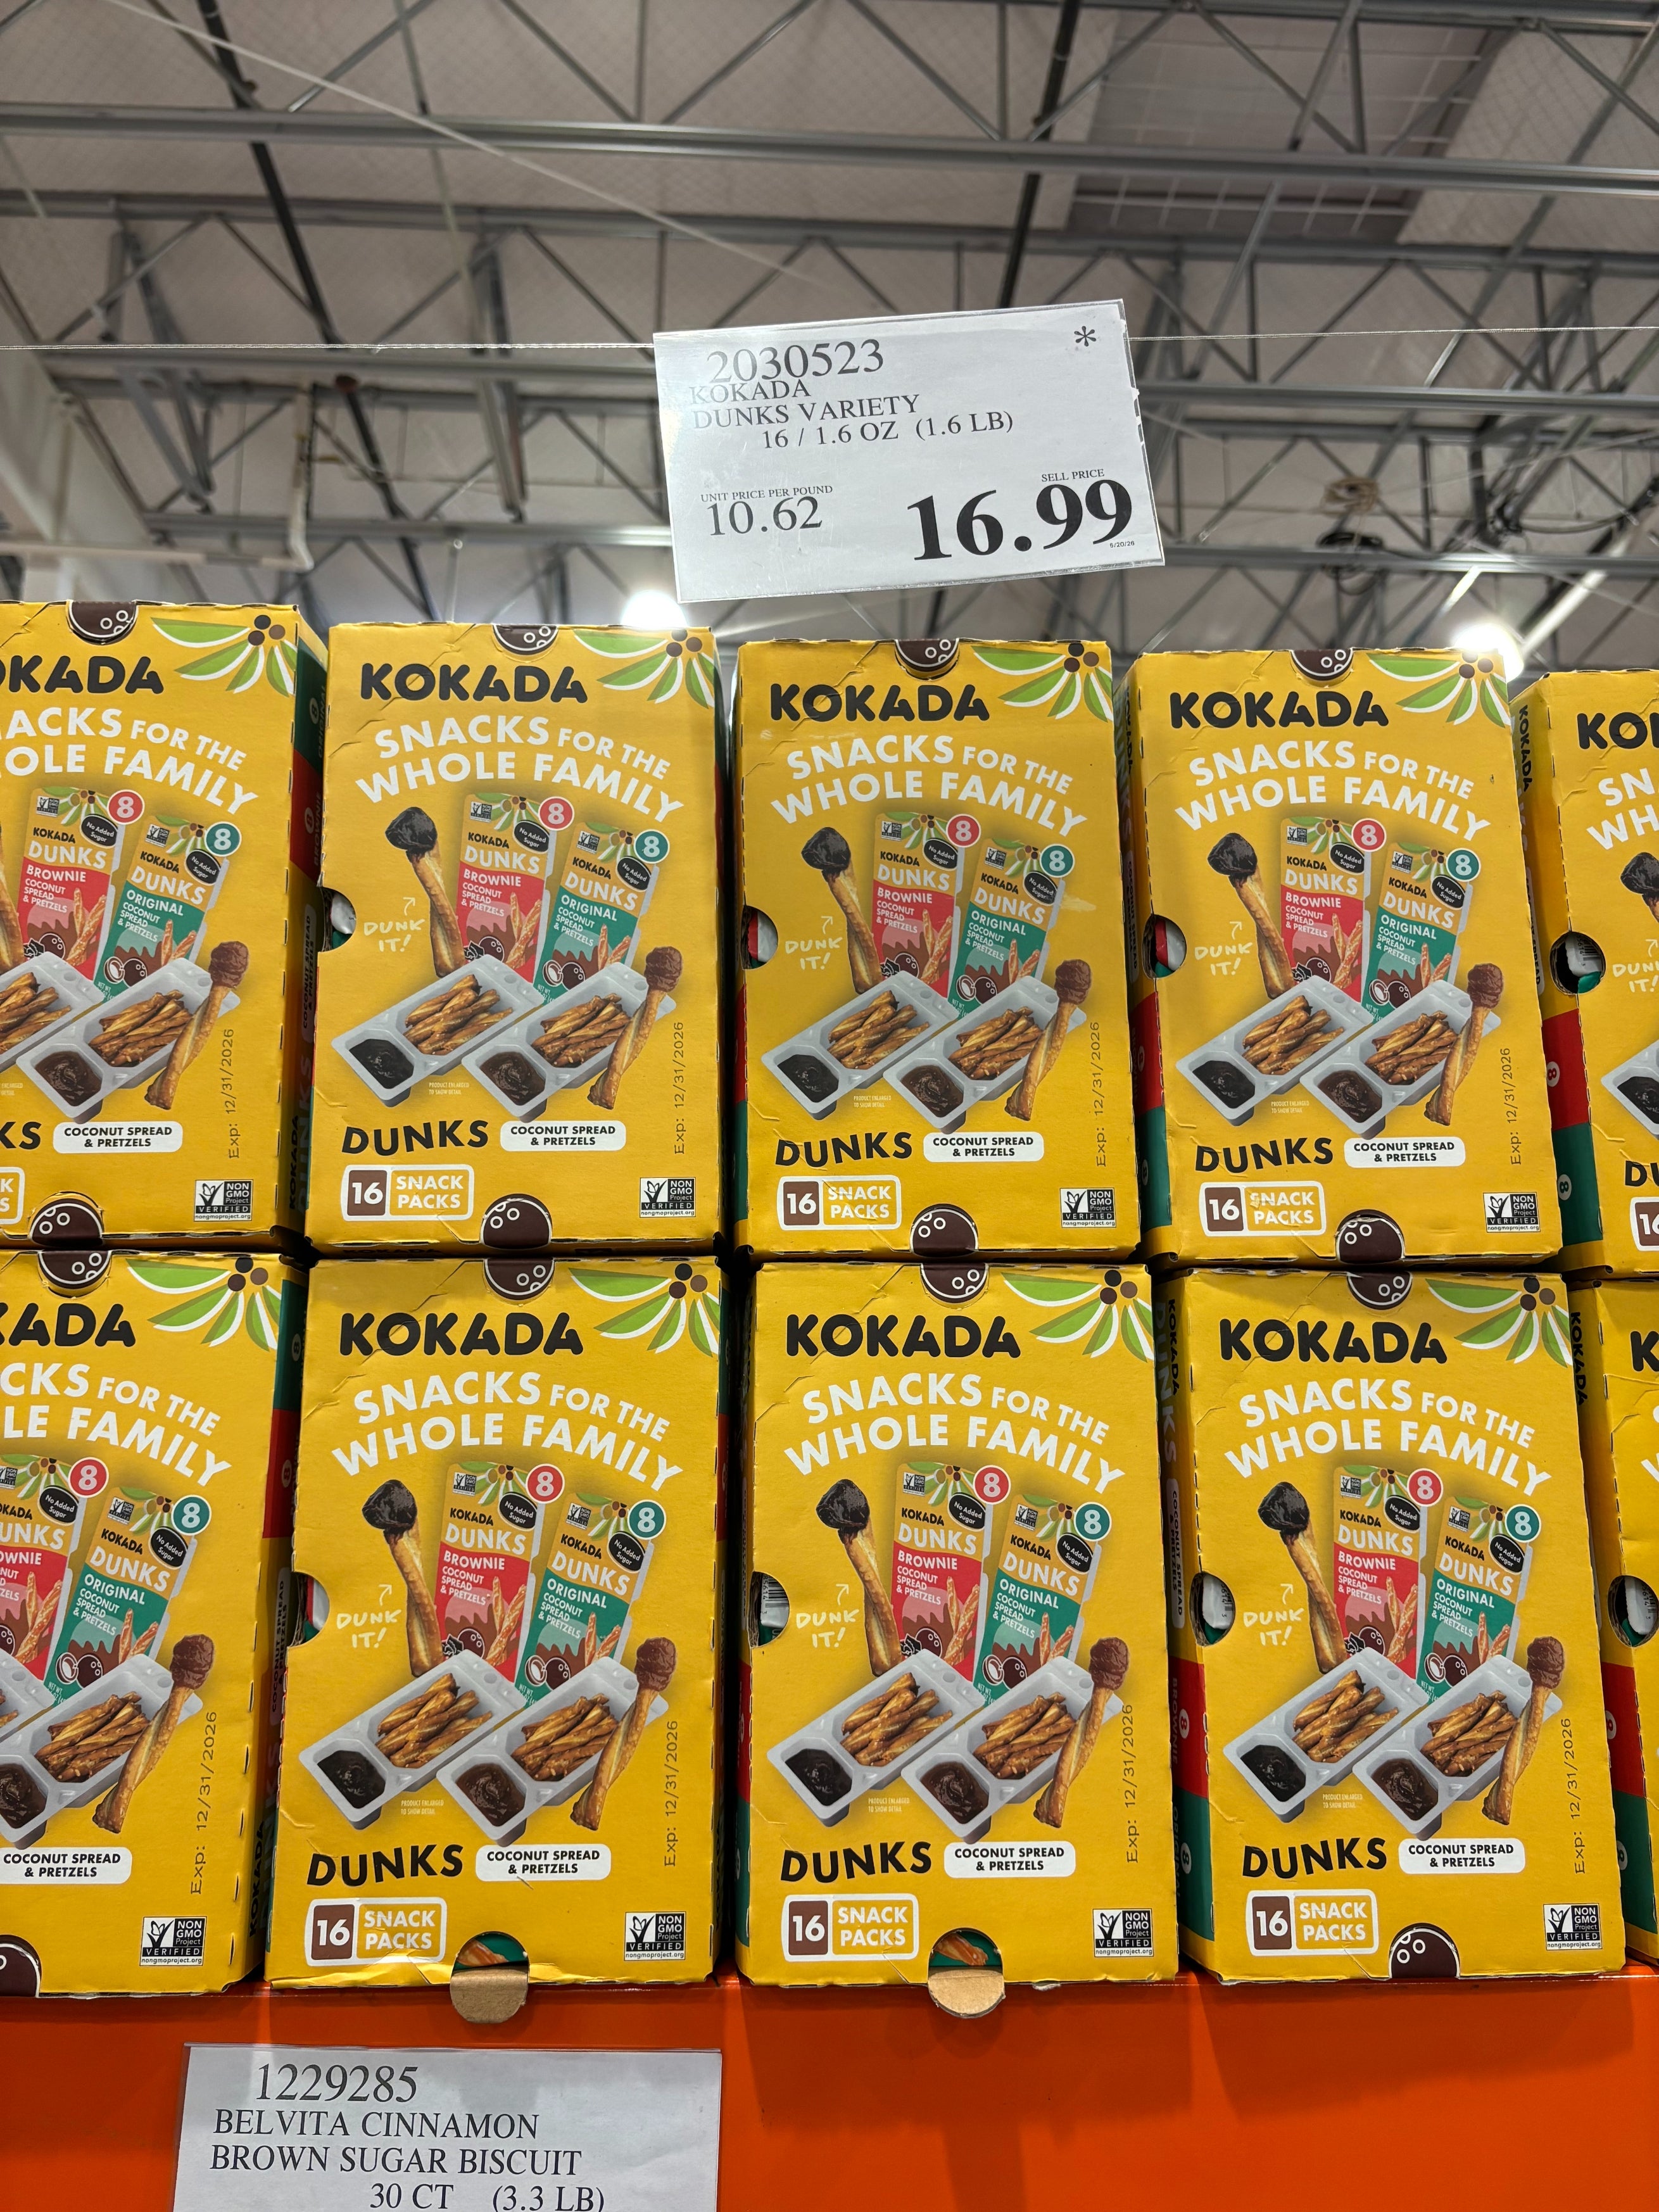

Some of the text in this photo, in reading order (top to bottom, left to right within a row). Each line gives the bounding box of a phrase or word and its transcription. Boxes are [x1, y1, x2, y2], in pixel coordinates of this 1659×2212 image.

[707, 339, 883, 383] 2030523
[689, 379, 811, 404] KOKADA
[693, 395, 919, 429] DUNKS VARIETY
[762, 411, 1013, 448] 16 / 1.6 OZ (1.6 LB)
[1042, 469, 1104, 482] SELL PRICE
[701, 486, 833, 502] UNIT PRICE PER POUND
[707, 496, 823, 536] 10.62
[907, 479, 1132, 560] 16.99
[361, 664, 587, 703] KOKADA
[771, 684, 989, 721] KOKADA
[1170, 691, 1389, 728] KOKADA
[131, 720, 246, 770] FOR THE
[375, 715, 670, 780] SNACKS FOR THE
[1519, 704, 1533, 792] KOKADA
[787, 735, 1073, 794] SNACKS FOR THE
[1190, 741, 1473, 799] SNACKS FOR THE
[104, 746, 258, 814] FAMILY
[356, 752, 683, 822] WHOLE FAMILY
[771, 771, 1087, 837] WHOLE FAMILY
[1175, 776, 1490, 841] WHOLE FAMILY
[220, 1030, 240, 1158] Exp: 12/31/2026
[672, 1022, 686, 1154] Exp: 12/31/2026
[1500, 1048, 1522, 1165] Exp: 12/31/2026
[342, 1120, 488, 1156] DUNKS
[776, 1132, 912, 1167] DUNKS
[1195, 1138, 1332, 1173] DUNKS
[352, 1182, 385, 1204] 16
[396, 1176, 462, 1190] SNACK
[828, 1186, 890, 1200] SNACK
[398, 1194, 460, 1208] PACKS
[787, 1193, 816, 1215] 16
[831, 1204, 889, 1218] PACKS
[1209, 1199, 1241, 1220] 16
[1251, 1192, 1314, 1206] SNACK
[1254, 1210, 1313, 1225] PACKS
[340, 1313, 583, 1355] KOKADA
[787, 1315, 1020, 1358] KOKADA
[1220, 1319, 1447, 1363] KOKADA
[98, 1377, 220, 1436] FOR THE
[355, 1372, 669, 1441] SNACKS FOR THE
[803, 1373, 1109, 1444] SNACKS FOR THE
[1240, 1379, 1534, 1448] SNACKS FOR THE
[68, 1407, 230, 1486] FAMILY
[332, 1413, 682, 1491] WHOLE FAMILY
[785, 1415, 1125, 1493] WHOLE FAMILY
[1225, 1419, 1551, 1496] WHOLE FAMILY
[983, 1472, 1000, 1498] 8
[902, 1507, 945, 1526] KOKADA
[954, 1501, 982, 1519] No Added
[959, 1515, 975, 1525] Sugar
[1084, 1510, 1102, 1534] 8
[897, 1523, 976, 1555] DUNKS
[1010, 1535, 1051, 1560] KOKADA
[1062, 1541, 1088, 1562] No Added
[897, 1550, 957, 1570] BROWNIE
[897, 1566, 938, 1584] COCONUT
[1002, 1552, 1080, 1596] DUNKS
[1064, 1553, 1081, 1567] Sugar
[897, 1576, 927, 1591] SPREAD
[905, 1588, 941, 1605] PRETZELS
[1000, 1579, 1059, 1609] ORIGINAL
[796, 1608, 859, 1626] DUNK
[994, 1602, 1023, 1622] SPREAD
[997, 1593, 1036, 1617] COCONUT
[812, 1629, 846, 1649] IT!
[1000, 1614, 1035, 1638] PRETZELS
[664, 1721, 679, 1866] Exp: 12/31/2026
[1121, 1705, 1139, 1863] Exp: 12/31/2026
[1561, 1719, 1585, 1874] Exp: 12/31/2026
[3, 1854, 120, 1864] COCONUT SPREAD
[307, 1845, 463, 1886] DUNKS
[781, 1842, 931, 1883] DUNKS
[954, 1847, 1064, 1859] COCONUT SPREAD
[976, 1859, 1044, 1871] & PRETZELS
[1243, 1838, 1386, 1878] DUNKS
[25, 1868, 98, 1878] & PRETZELS
[365, 1911, 434, 1927] SNACK
[838, 1907, 907, 1924] SNACK
[1125, 1912, 1148, 1921] NON
[1256, 1911, 1288, 1936] 16
[1300, 1902, 1366, 1919] SNACK
[317, 1919, 350, 1945] 16
[366, 1933, 431, 1949] PACKS
[793, 1915, 825, 1942] 16
[841, 1929, 905, 1946] PACKS
[1126, 1930, 1149, 1938] Project
[1304, 1924, 1365, 1941] PACKS
[256, 2063, 419, 2102] 1229285
[213, 2109, 539, 2139] BELVITA CINNAMON
[210, 2145, 581, 2175] BROWN SUGAR BISCUIT
[370, 2184, 604, 2212] 30 CT (3.3 LB)
